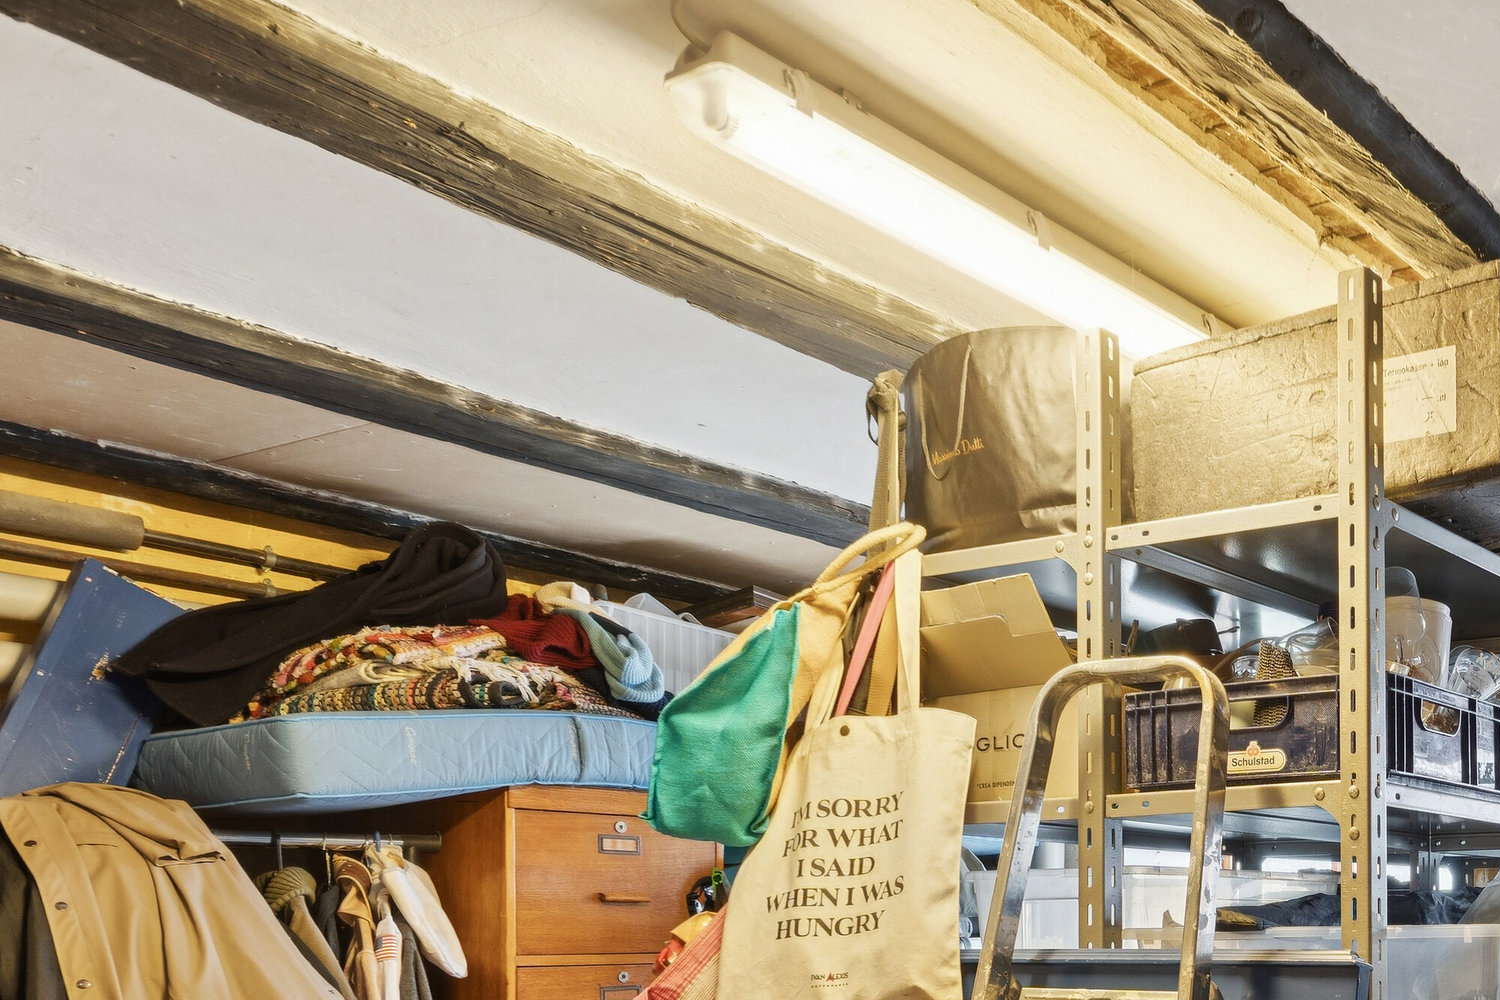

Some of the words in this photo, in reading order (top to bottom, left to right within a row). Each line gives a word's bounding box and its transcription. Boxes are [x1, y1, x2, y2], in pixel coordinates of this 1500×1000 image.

[1384, 363, 1427, 377] Termokasse
[961, 437, 984, 454] Dutti
[1231, 755, 1275, 767] Schulstad
[816, 791, 904, 818] SORRY
[782, 829, 820, 858] FOR
[826, 819, 904, 848] WHAT
[796, 858, 804, 878] I
[810, 856, 875, 878] SAID
[766, 887, 839, 913] WHEN
[845, 887, 855, 906] I
[860, 875, 904, 903] WAS
[776, 910, 886, 940] HUNGRY
